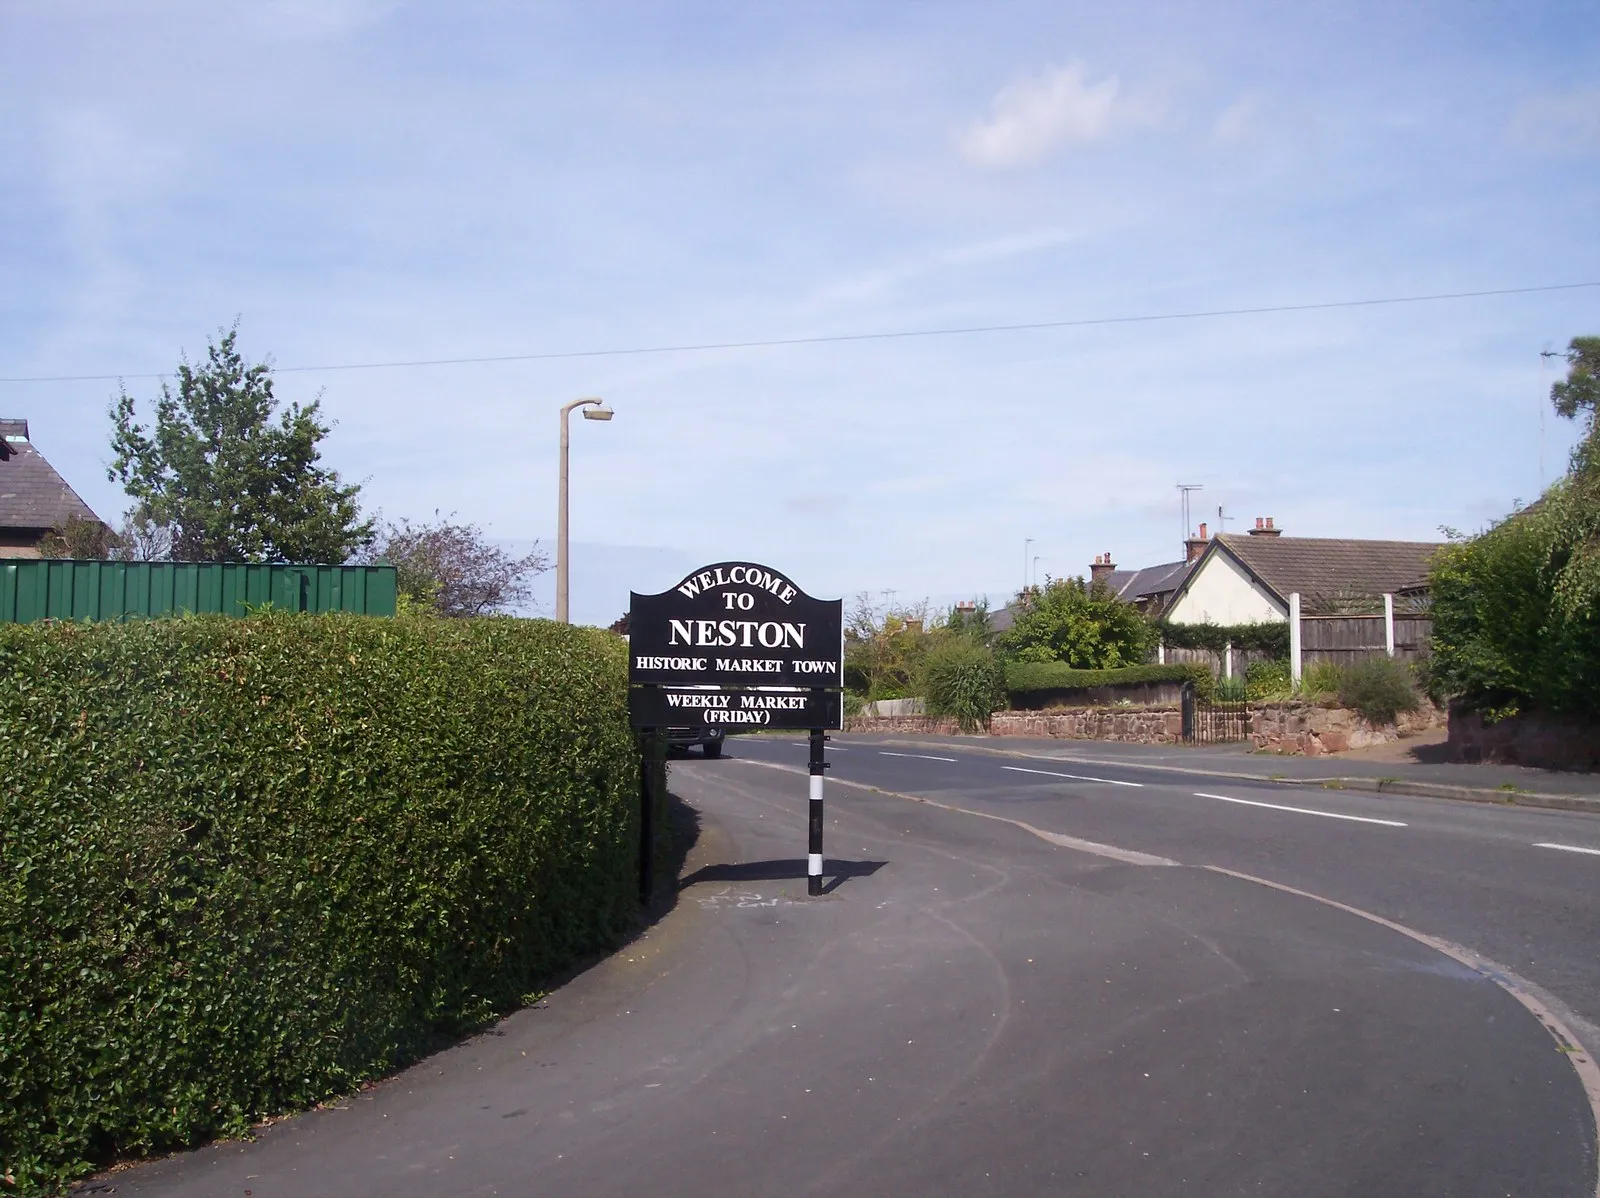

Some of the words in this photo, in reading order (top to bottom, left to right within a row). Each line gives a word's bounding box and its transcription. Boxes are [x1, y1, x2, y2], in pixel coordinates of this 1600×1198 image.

[677, 566, 797, 605] WELCOME
[722, 592, 755, 610] TO
[668, 619, 807, 649] NESTON
[635, 656, 708, 671] HISTORIC
[715, 658, 784, 673] MARKET
[791, 660, 837, 674] TOWN
[666, 694, 731, 709] WEEKLY
[740, 695, 808, 710] MARKET
[703, 708, 771, 725] (FRIDAY)
